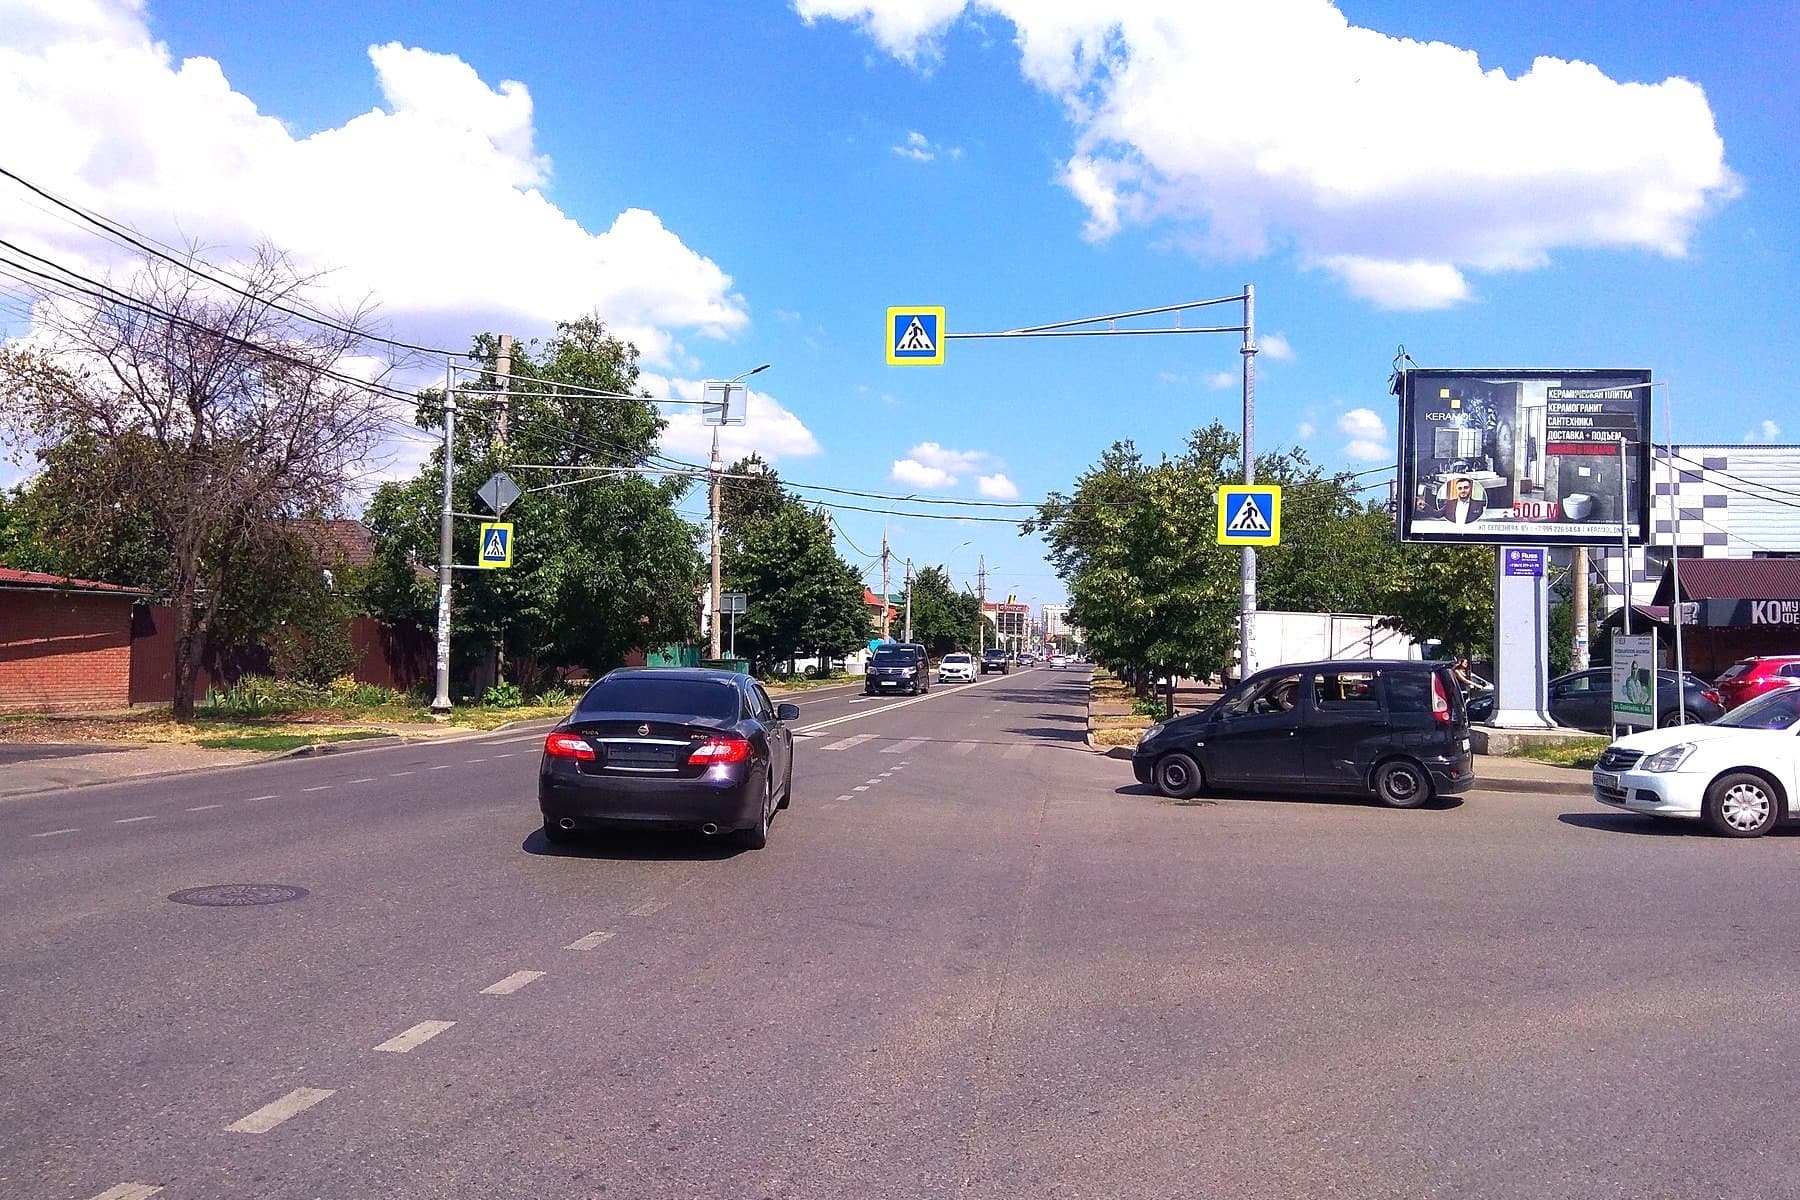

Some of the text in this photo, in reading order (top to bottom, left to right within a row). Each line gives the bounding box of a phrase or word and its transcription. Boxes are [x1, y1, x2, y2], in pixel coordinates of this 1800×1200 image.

[1605, 390, 1633, 400] ПЛИТКА
[1548, 403, 1603, 413] КЕРАМОГРАНИТ
[1547, 417, 1594, 426] САНТЕХНИКА
[1547, 431, 1584, 441] ДОСТАВКА
[1512, 503, 1541, 518] 500
